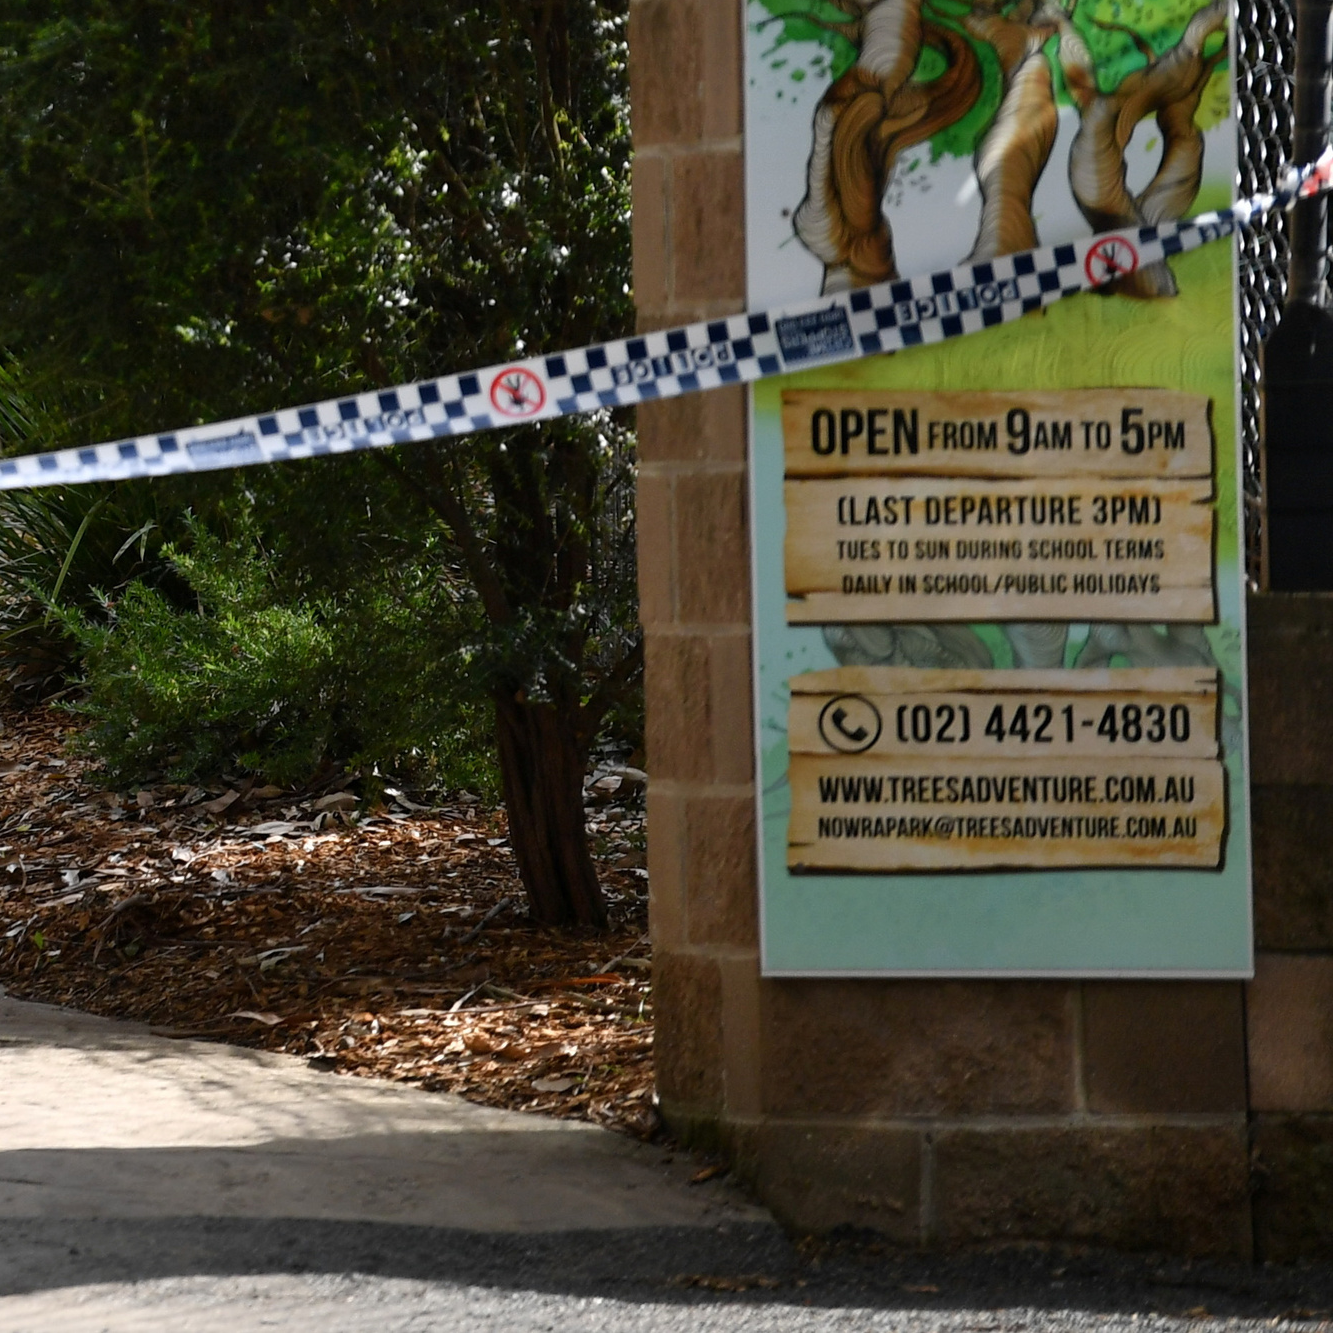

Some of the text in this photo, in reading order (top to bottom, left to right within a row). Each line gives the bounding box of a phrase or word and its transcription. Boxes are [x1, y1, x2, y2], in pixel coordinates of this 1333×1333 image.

[810, 407, 1185, 456] OPEN FROM 9AM TO 5PM
[837, 495, 1162, 526] (LAST DEPARTURE 3PM)
[836, 539, 1165, 560] TUES TO SUN DURING SCHOOL TERMS
[842, 574, 1161, 596] DAILY IN SCHOOL/PUBLIC HOLIDAYS
[896, 703, 1191, 744] (02) 4421-4830
[818, 775, 1195, 804] WWW.TREESADVENTURE.COM.AU
[818, 815, 1197, 839] NOWRAPARK@TREESADVENTURE.COM.AU
